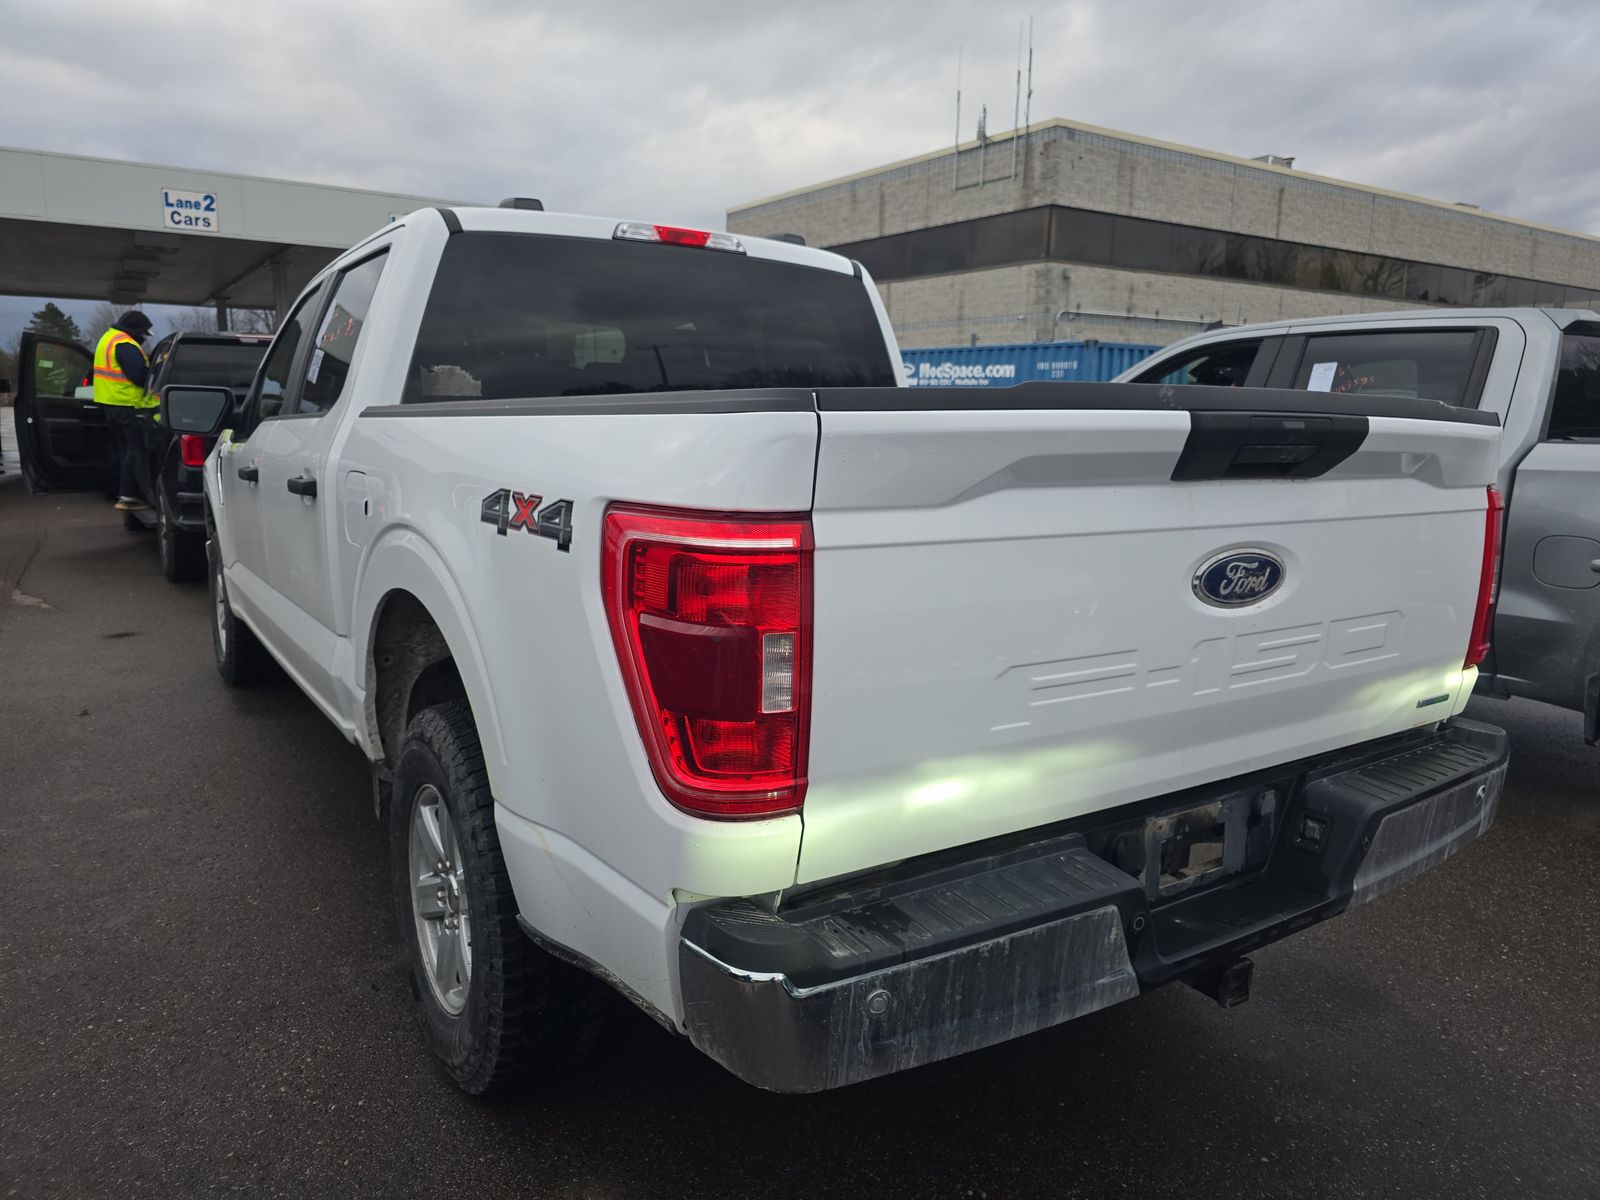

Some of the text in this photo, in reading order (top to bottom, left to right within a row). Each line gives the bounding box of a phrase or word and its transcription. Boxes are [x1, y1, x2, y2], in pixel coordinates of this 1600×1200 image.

[171, 211, 211, 228] Cars
[1220, 561, 1270, 596] Ford
[991, 609, 1405, 732] F-150
